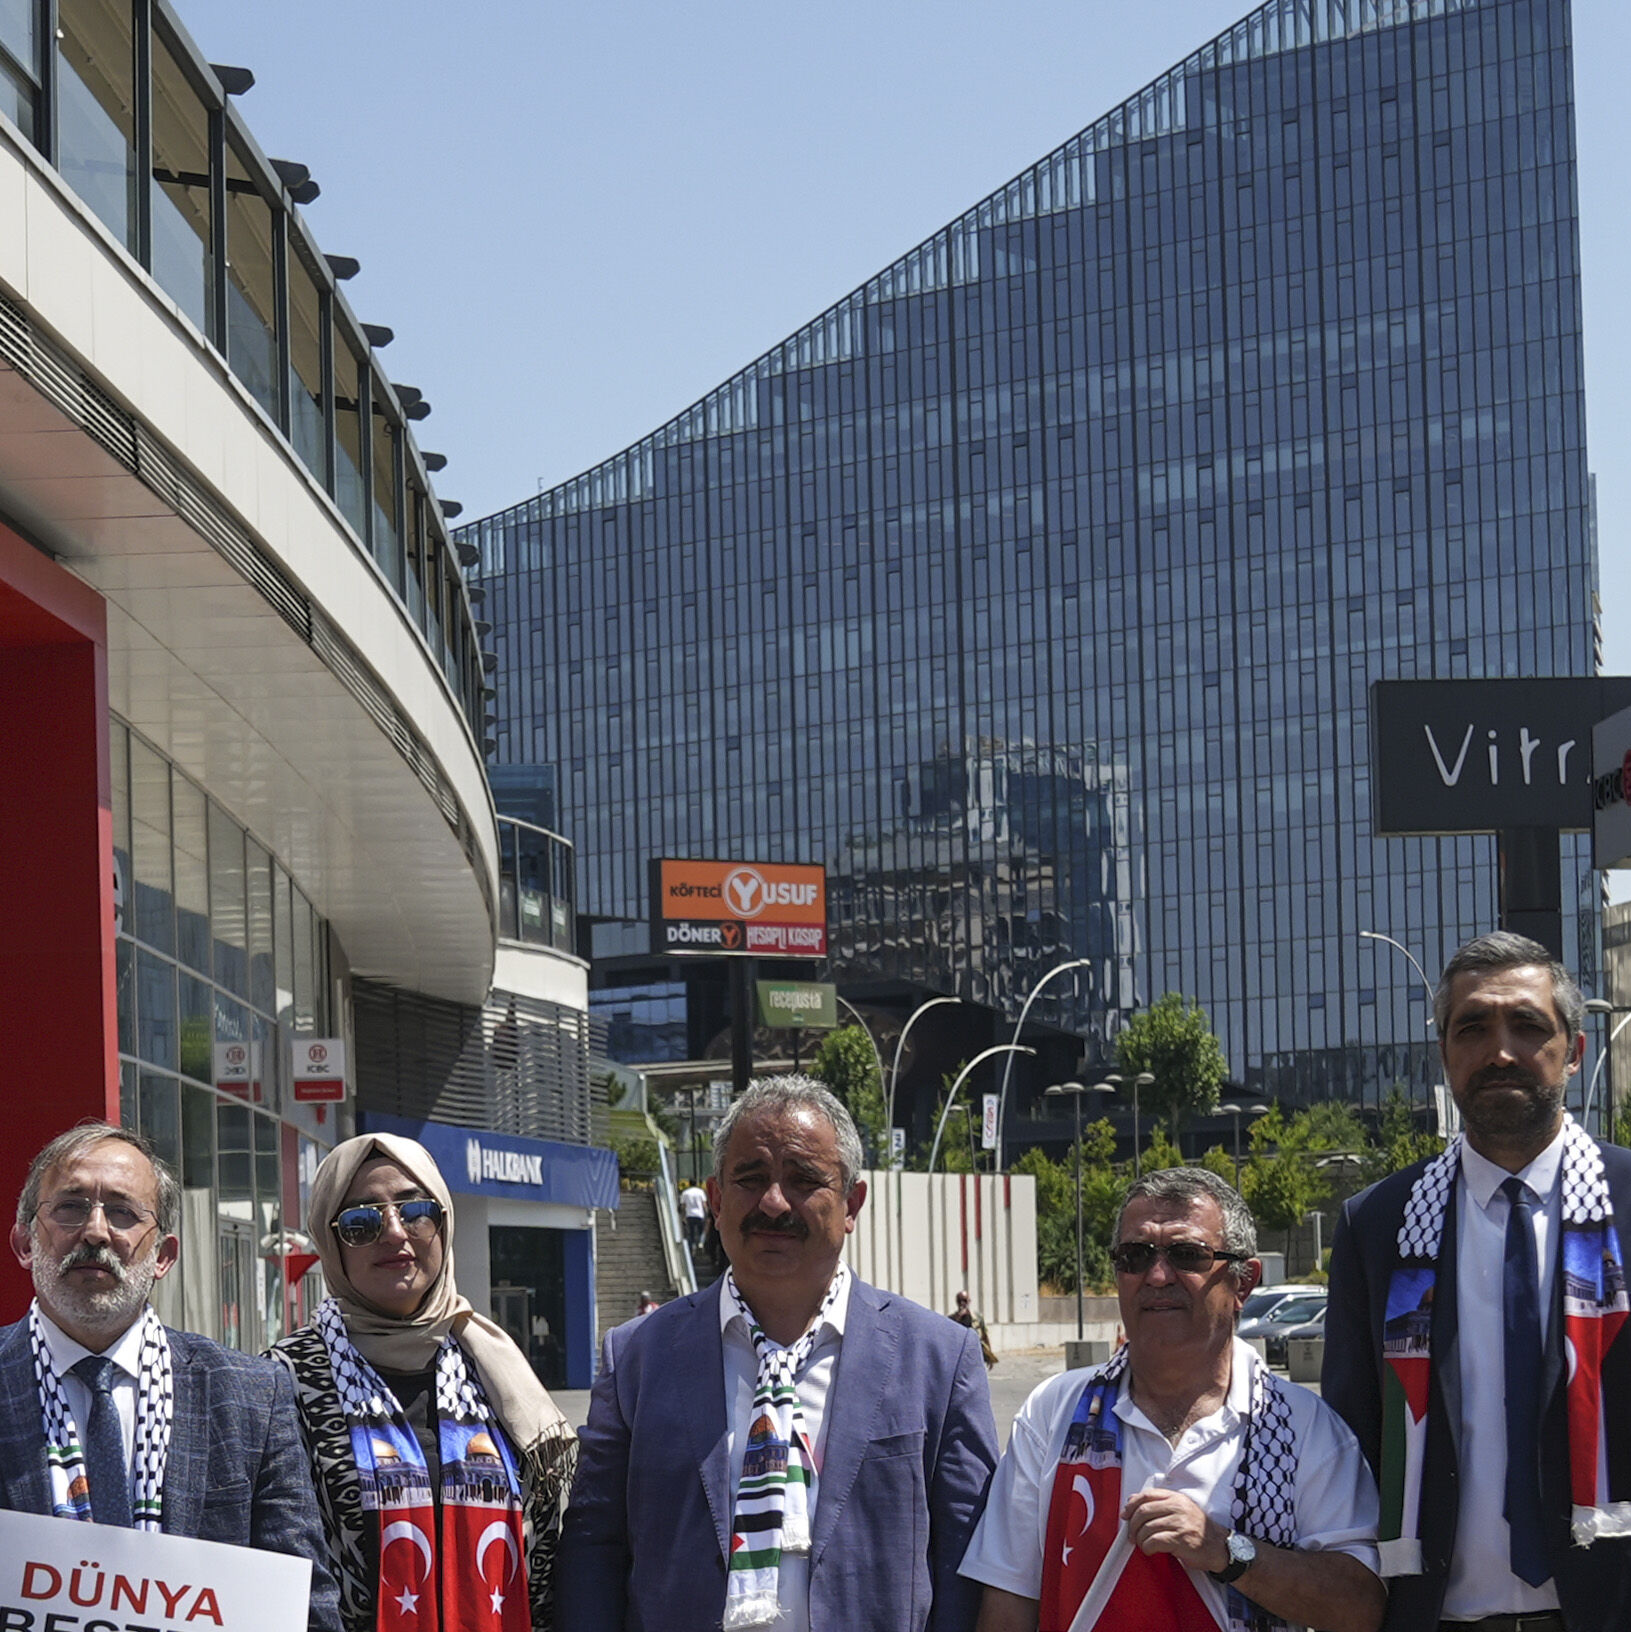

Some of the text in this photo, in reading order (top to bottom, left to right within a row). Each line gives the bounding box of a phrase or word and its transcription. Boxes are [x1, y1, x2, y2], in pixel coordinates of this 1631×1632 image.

[1424, 723, 1590, 787] Vitr
[670, 876, 817, 912] KÖFTECİ YUSUF
[667, 923, 722, 943] DÖNER
[482, 1148, 543, 1185] HALKBANK
[21, 1560, 225, 1626] DÜNYA
